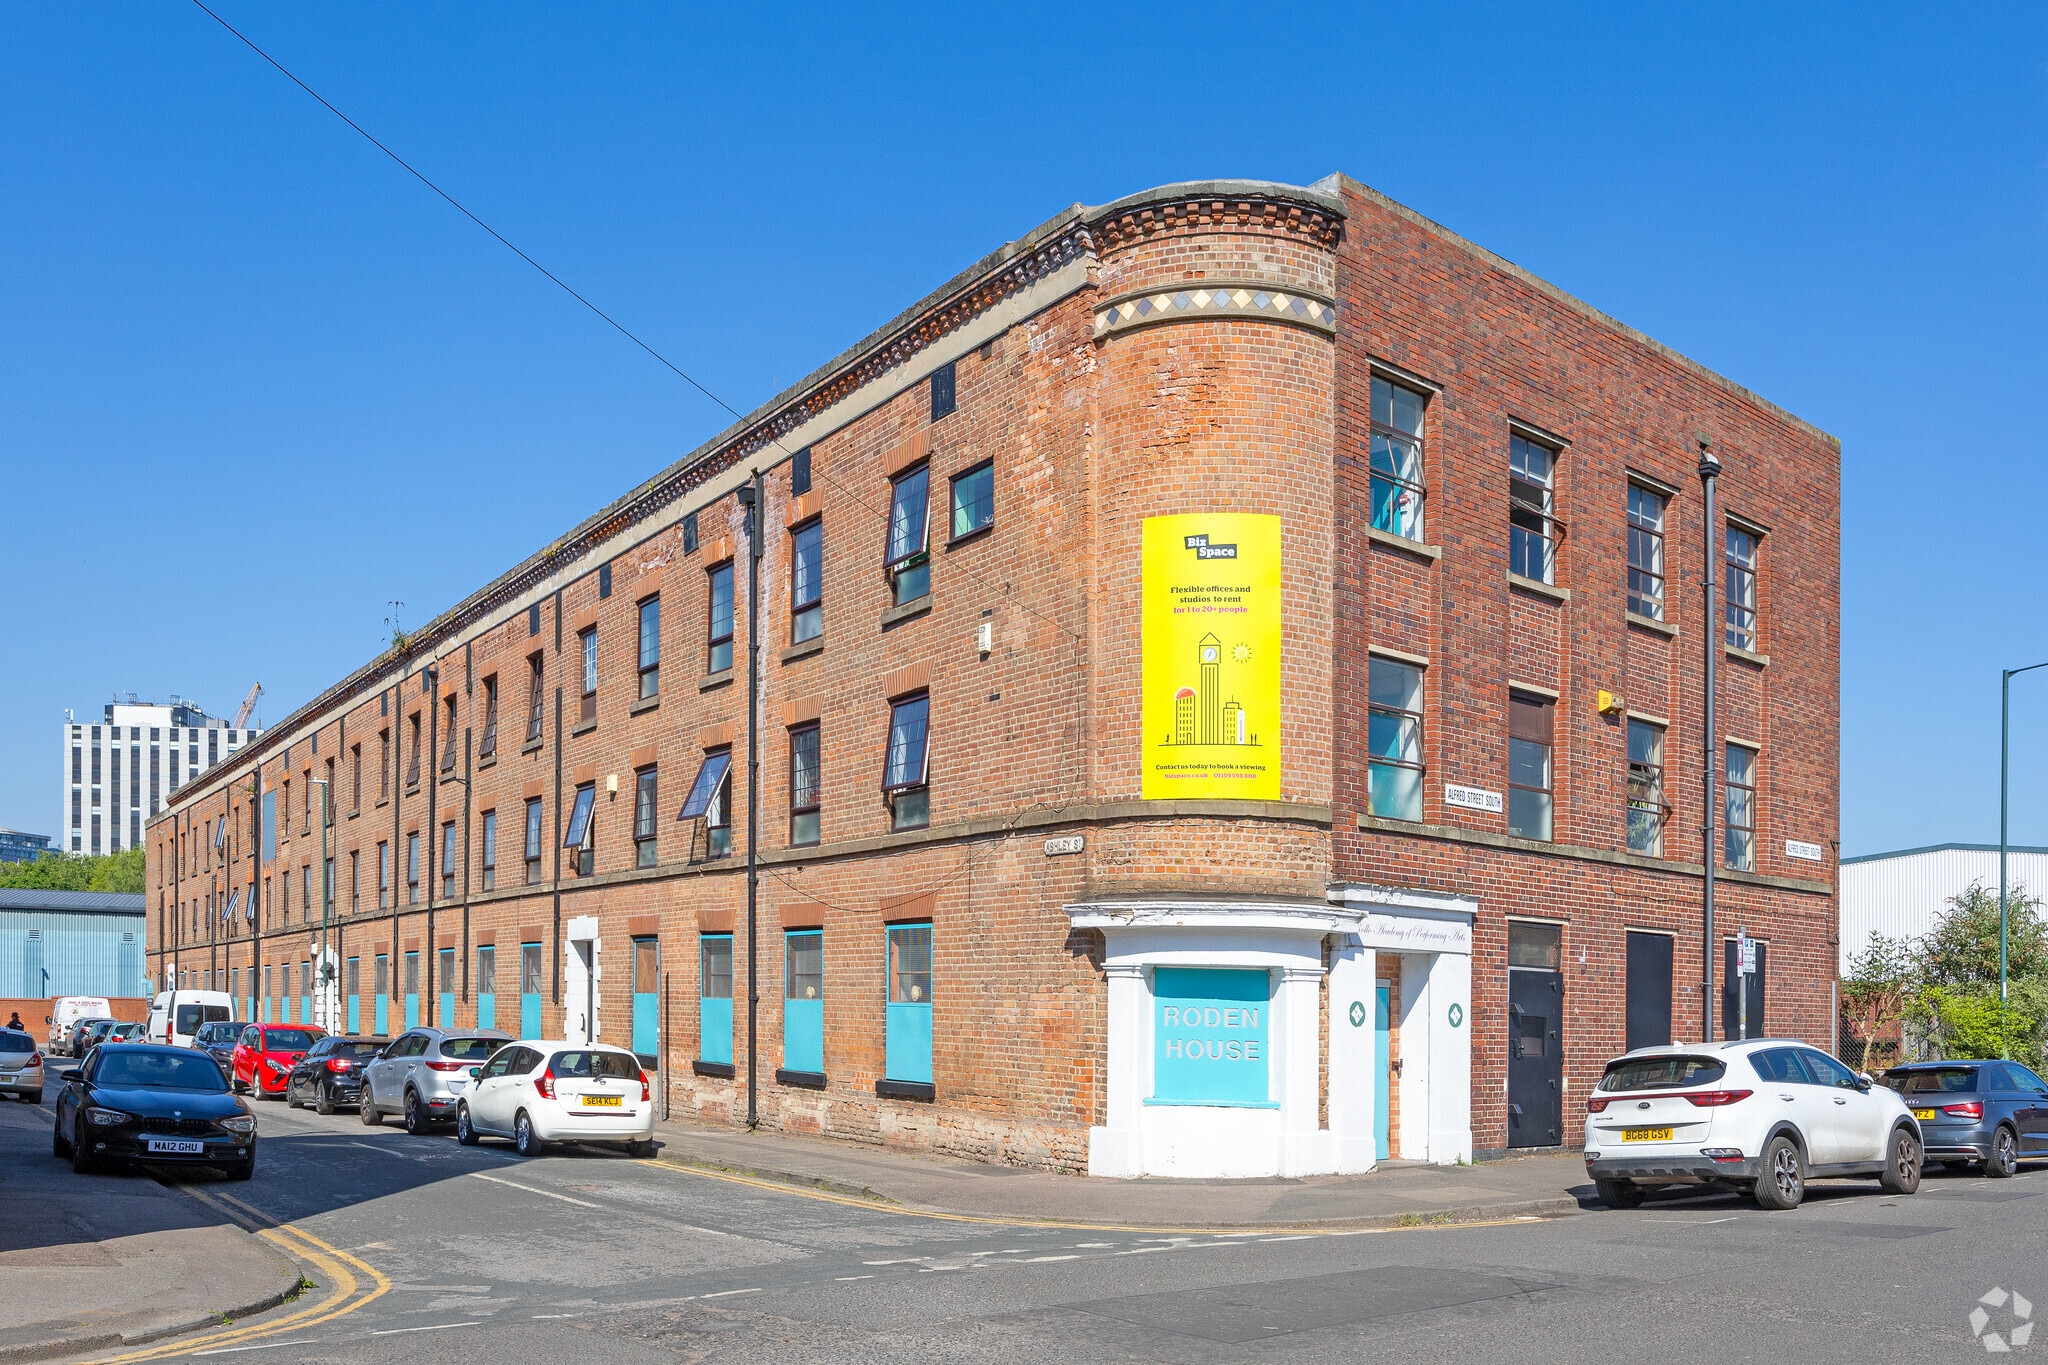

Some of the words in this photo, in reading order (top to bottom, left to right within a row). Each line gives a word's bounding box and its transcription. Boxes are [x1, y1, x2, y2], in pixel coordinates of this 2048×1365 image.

[1187, 537, 1207, 547] Biz
[1199, 547, 1235, 558] Space
[1170, 586, 1205, 594] Flexible
[1448, 788, 1466, 801] ALFRED
[1467, 791, 1484, 805] STREET
[1486, 795, 1501, 808] SOUTH
[1046, 839, 1071, 852] ASHLEY
[1405, 929, 1412, 940] of
[1412, 926, 1447, 944] Performing
[1449, 927, 1465, 940] Arts
[1163, 1005, 1259, 1028] RODEN
[1166, 1038, 1260, 1060] HOUSE
[586, 1097, 603, 1105] SE14
[1625, 1129, 1649, 1140] BC68
[1651, 1128, 1670, 1139] GSV
[154, 1141, 177, 1151] MA12
[178, 1142, 198, 1152] GHU
